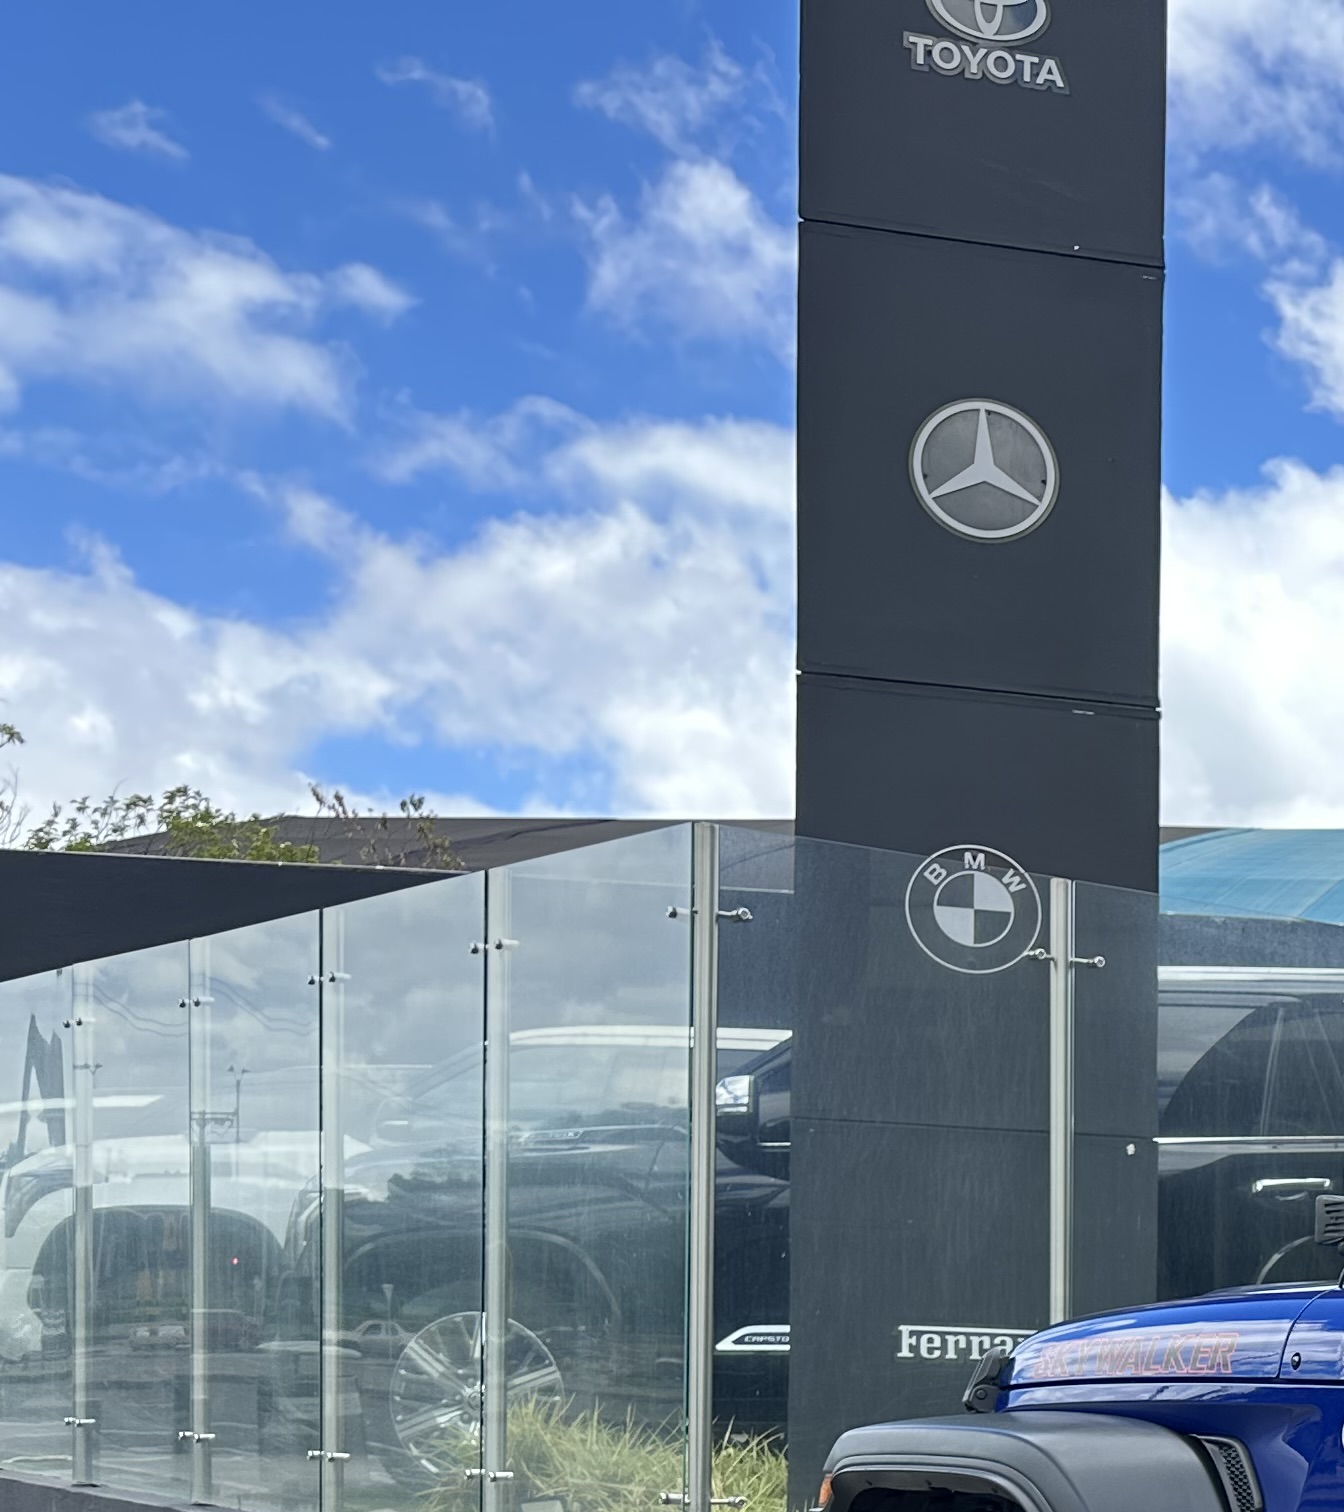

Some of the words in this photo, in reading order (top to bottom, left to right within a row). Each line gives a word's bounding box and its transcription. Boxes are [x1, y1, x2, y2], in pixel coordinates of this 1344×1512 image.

[908, 36, 1065, 89] TOYOTA
[923, 851, 1027, 894] BMW
[897, 1325, 1038, 1360] Ferra
[1031, 1332, 1240, 1378] SKYWALKER
